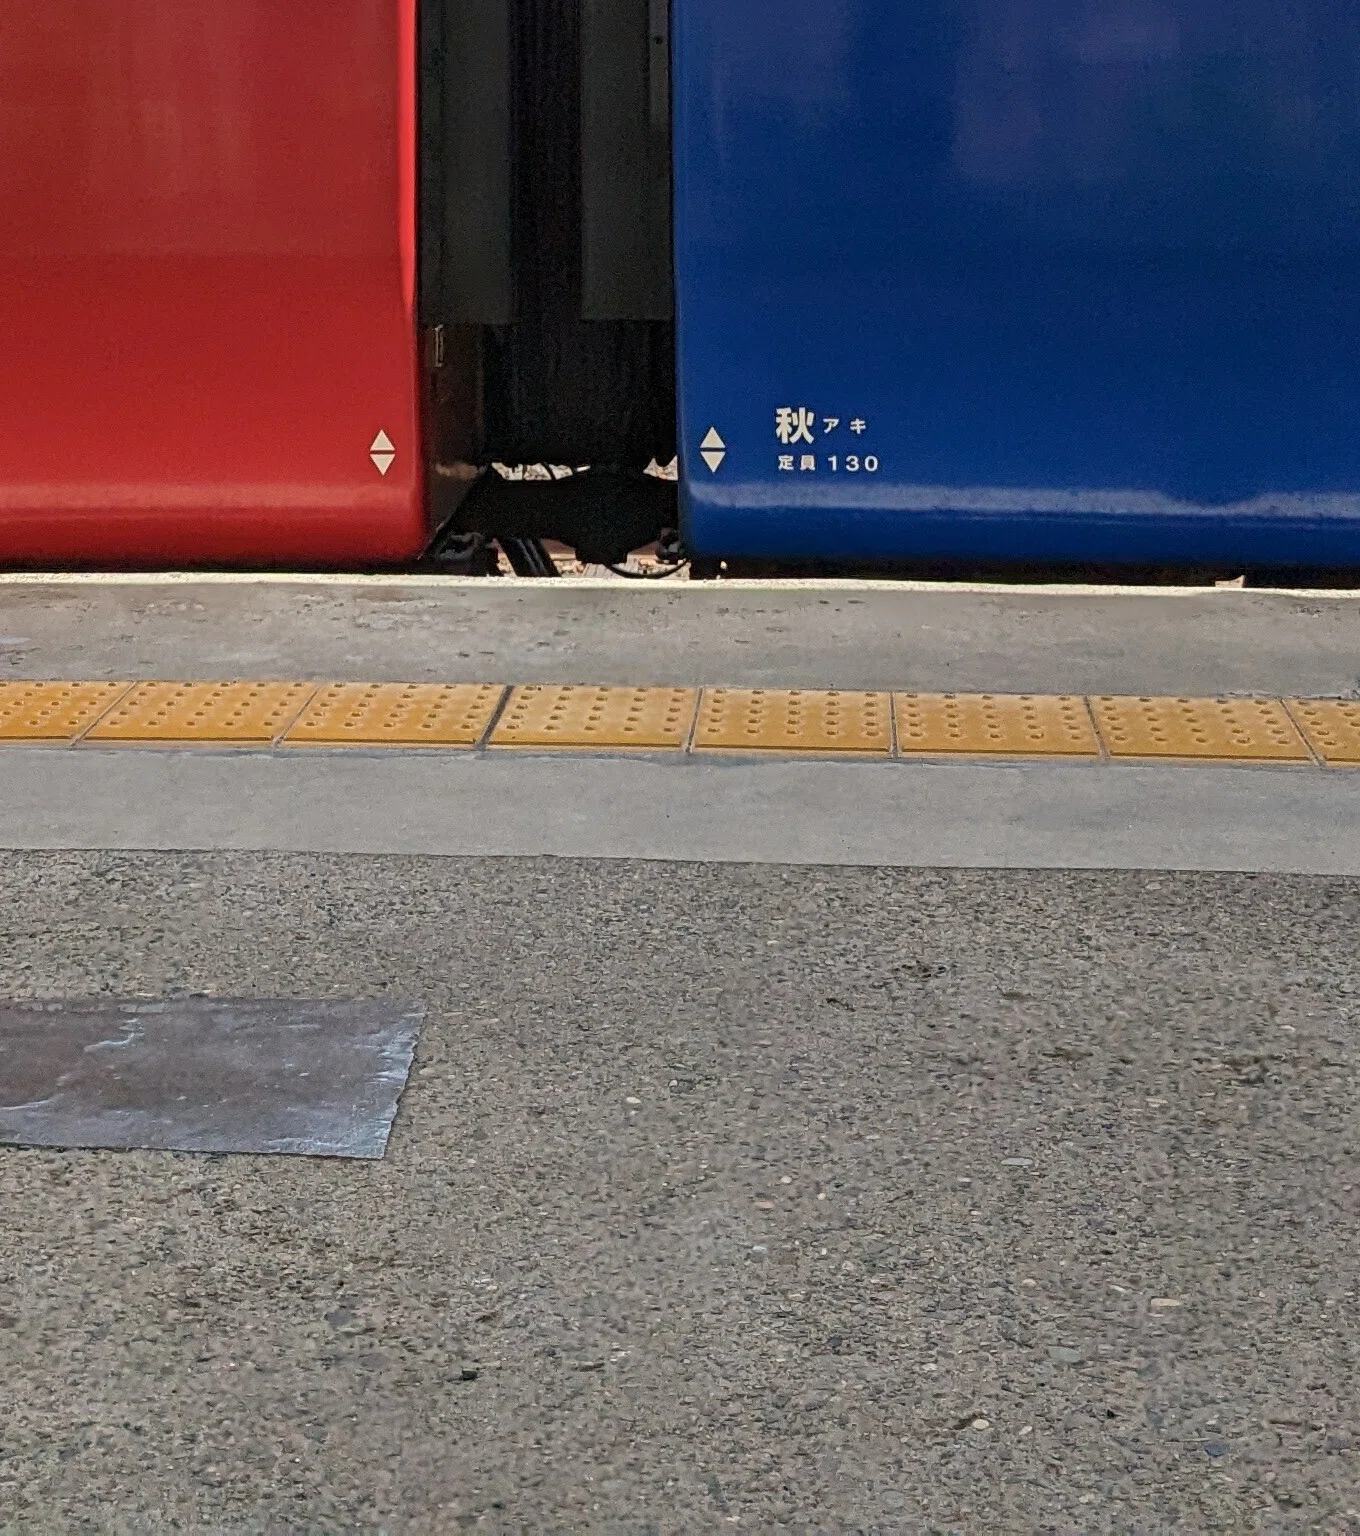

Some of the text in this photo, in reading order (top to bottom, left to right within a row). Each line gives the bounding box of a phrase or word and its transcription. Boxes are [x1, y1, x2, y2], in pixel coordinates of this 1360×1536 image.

[776, 407, 867, 444] 秋 アキ
[778, 455, 879, 472] 定員 130
